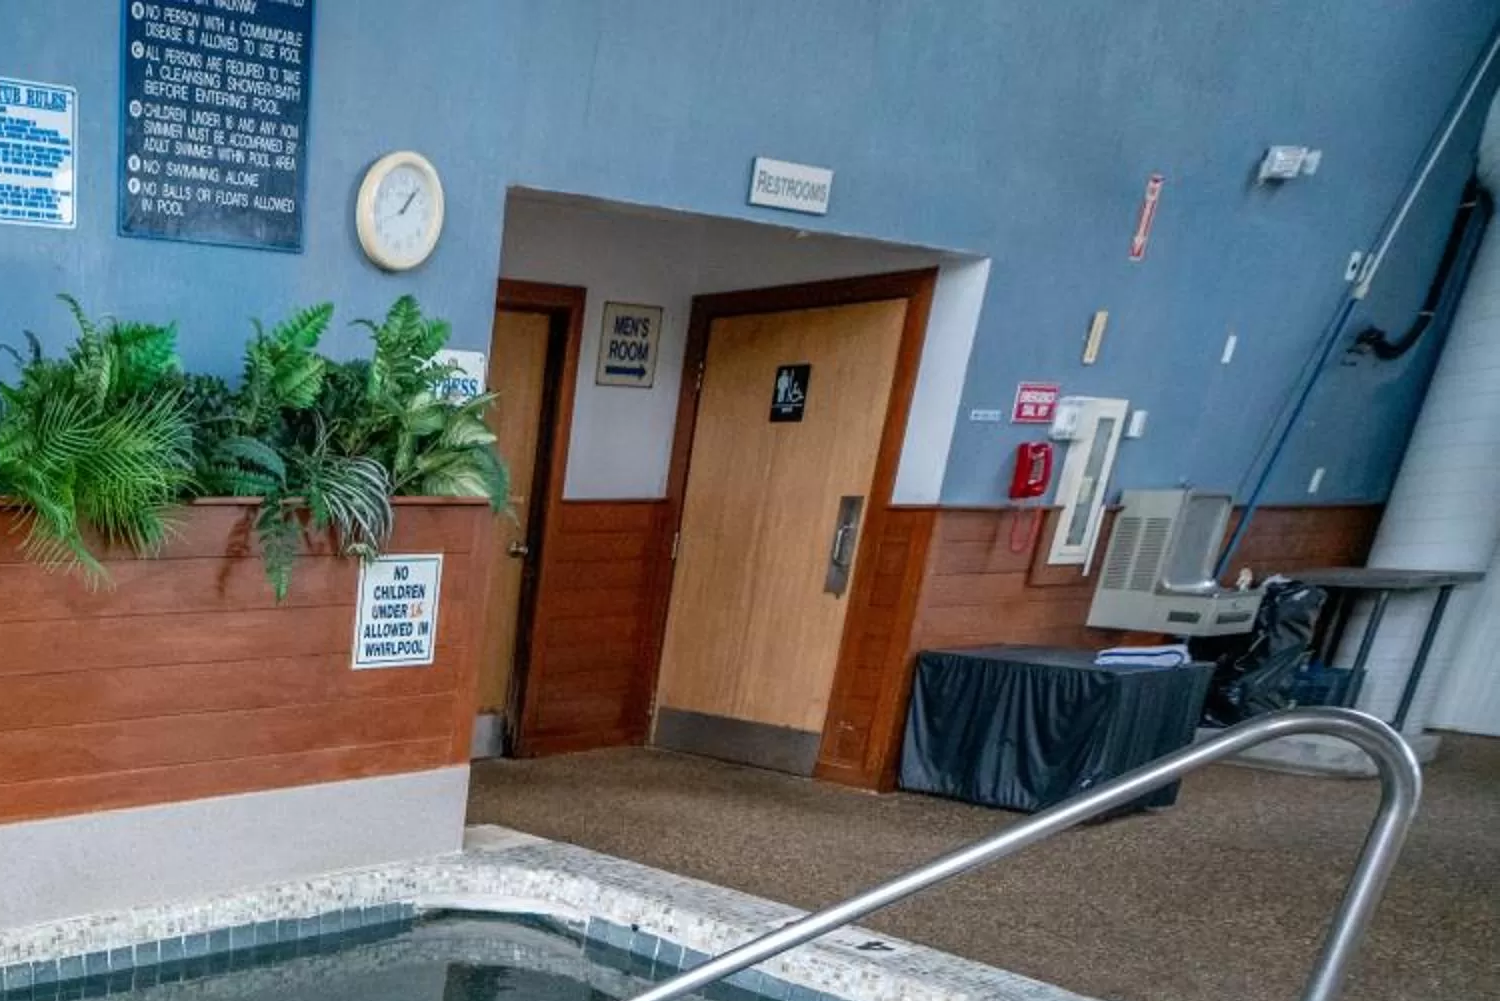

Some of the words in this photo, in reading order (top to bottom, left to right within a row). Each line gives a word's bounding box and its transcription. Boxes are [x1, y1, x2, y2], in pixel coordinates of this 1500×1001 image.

[145, 4, 161, 21] NO
[164, 7, 199, 28] PERSON
[204, 15, 225, 33] WITH
[239, 23, 303, 48] COMMUNICABLE
[145, 21, 183, 43] DISEASE
[200, 32, 239, 52] ALLOWED
[243, 39, 255, 55] TO
[260, 43, 275, 59] USE
[279, 46, 301, 64] POOL
[145, 45, 160, 61] ALL
[165, 48, 203, 69] PERSONS
[206, 57, 222, 73] ARE
[268, 66, 279, 82] TO
[283, 69, 301, 85] TAKE
[145, 63, 153, 77] A
[159, 65, 221, 89] CLEANSING
[26, 88, 67, 113] RULES
[144, 80, 189, 101] BEFORE
[195, 87, 247, 110] ENTERING
[252, 97, 281, 116] POOL
[143, 103, 187, 123] CHILDREN
[191, 108, 221, 128] UNDER
[238, 117, 255, 134] AND
[259, 120, 277, 137] ANY
[143, 119, 183, 139] SWIMMER
[187, 125, 209, 142] MUST
[213, 129, 225, 146] BE
[229, 131, 283, 153] ACCOMPANIED
[285, 139, 298, 156] BY
[143, 137, 171, 154] ADULT
[174, 140, 214, 160] SWIMMER
[217, 147, 246, 165] WITHIN
[249, 151, 271, 168] POOL
[274, 153, 297, 171] AREA
[143, 159, 161, 176] NO
[165, 161, 220, 183] SWIMMING
[225, 171, 260, 188] ALONE
[756, 169, 827, 203] RESTROOMS
[141, 181, 157, 197] NO
[161, 183, 192, 201] BALLS
[195, 187, 211, 204] OR
[215, 190, 249, 208] FLOATS
[253, 196, 296, 214] ALLOWED
[141, 198, 153, 212] IN
[157, 199, 185, 217] POOL
[614, 315, 651, 338] MEN'S
[608, 339, 650, 361] ROOM
[393, 565, 409, 581] NO
[373, 584, 426, 601] CHILDREN
[371, 603, 408, 619] UNDER
[364, 622, 413, 639] ALLOWED
[417, 621, 429, 636] IN
[365, 639, 425, 657] WHIRLPOOL
